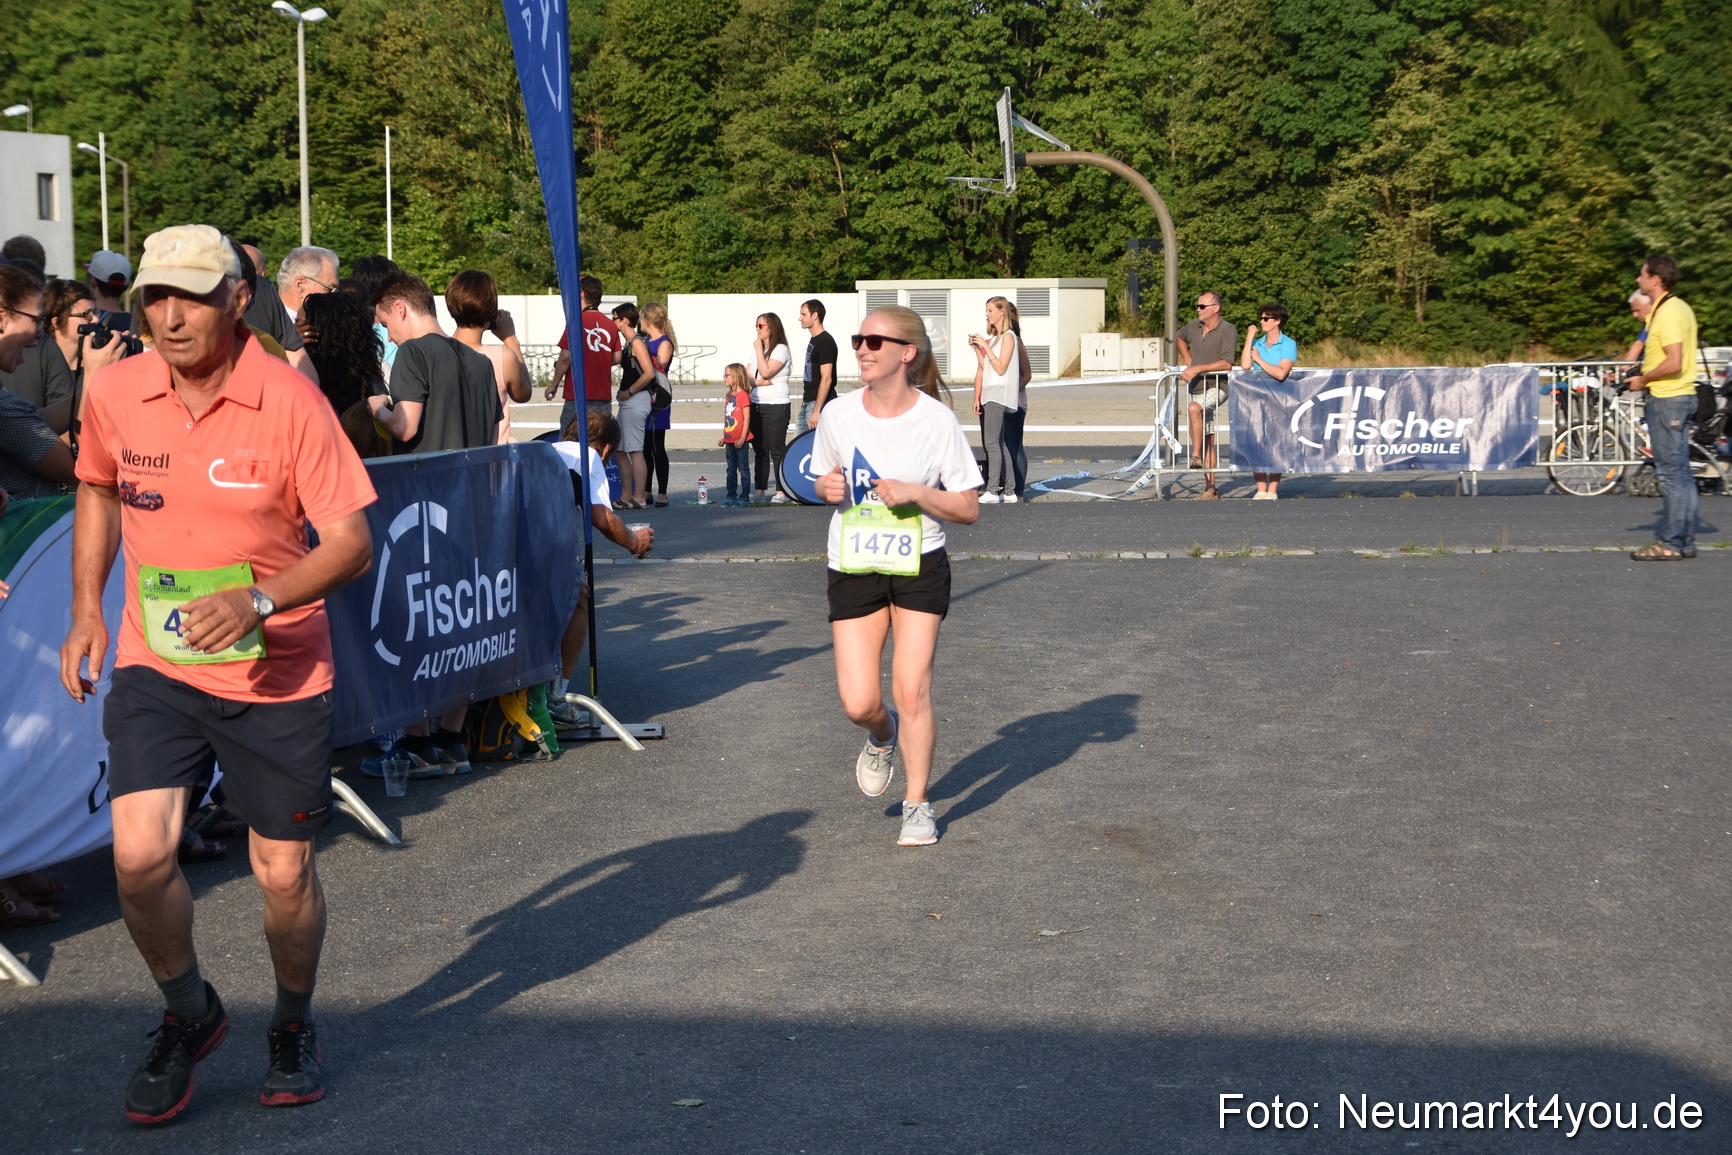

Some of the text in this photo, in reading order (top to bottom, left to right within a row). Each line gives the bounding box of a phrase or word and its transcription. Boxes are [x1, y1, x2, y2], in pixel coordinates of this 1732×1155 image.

[1323, 411, 1474, 440] Fischer
[122, 448, 170, 469] Wendl
[1336, 443, 1462, 457] AUTOMOBILE
[850, 532, 912, 557] 1478
[412, 628, 517, 682] AUTOMOBILE
